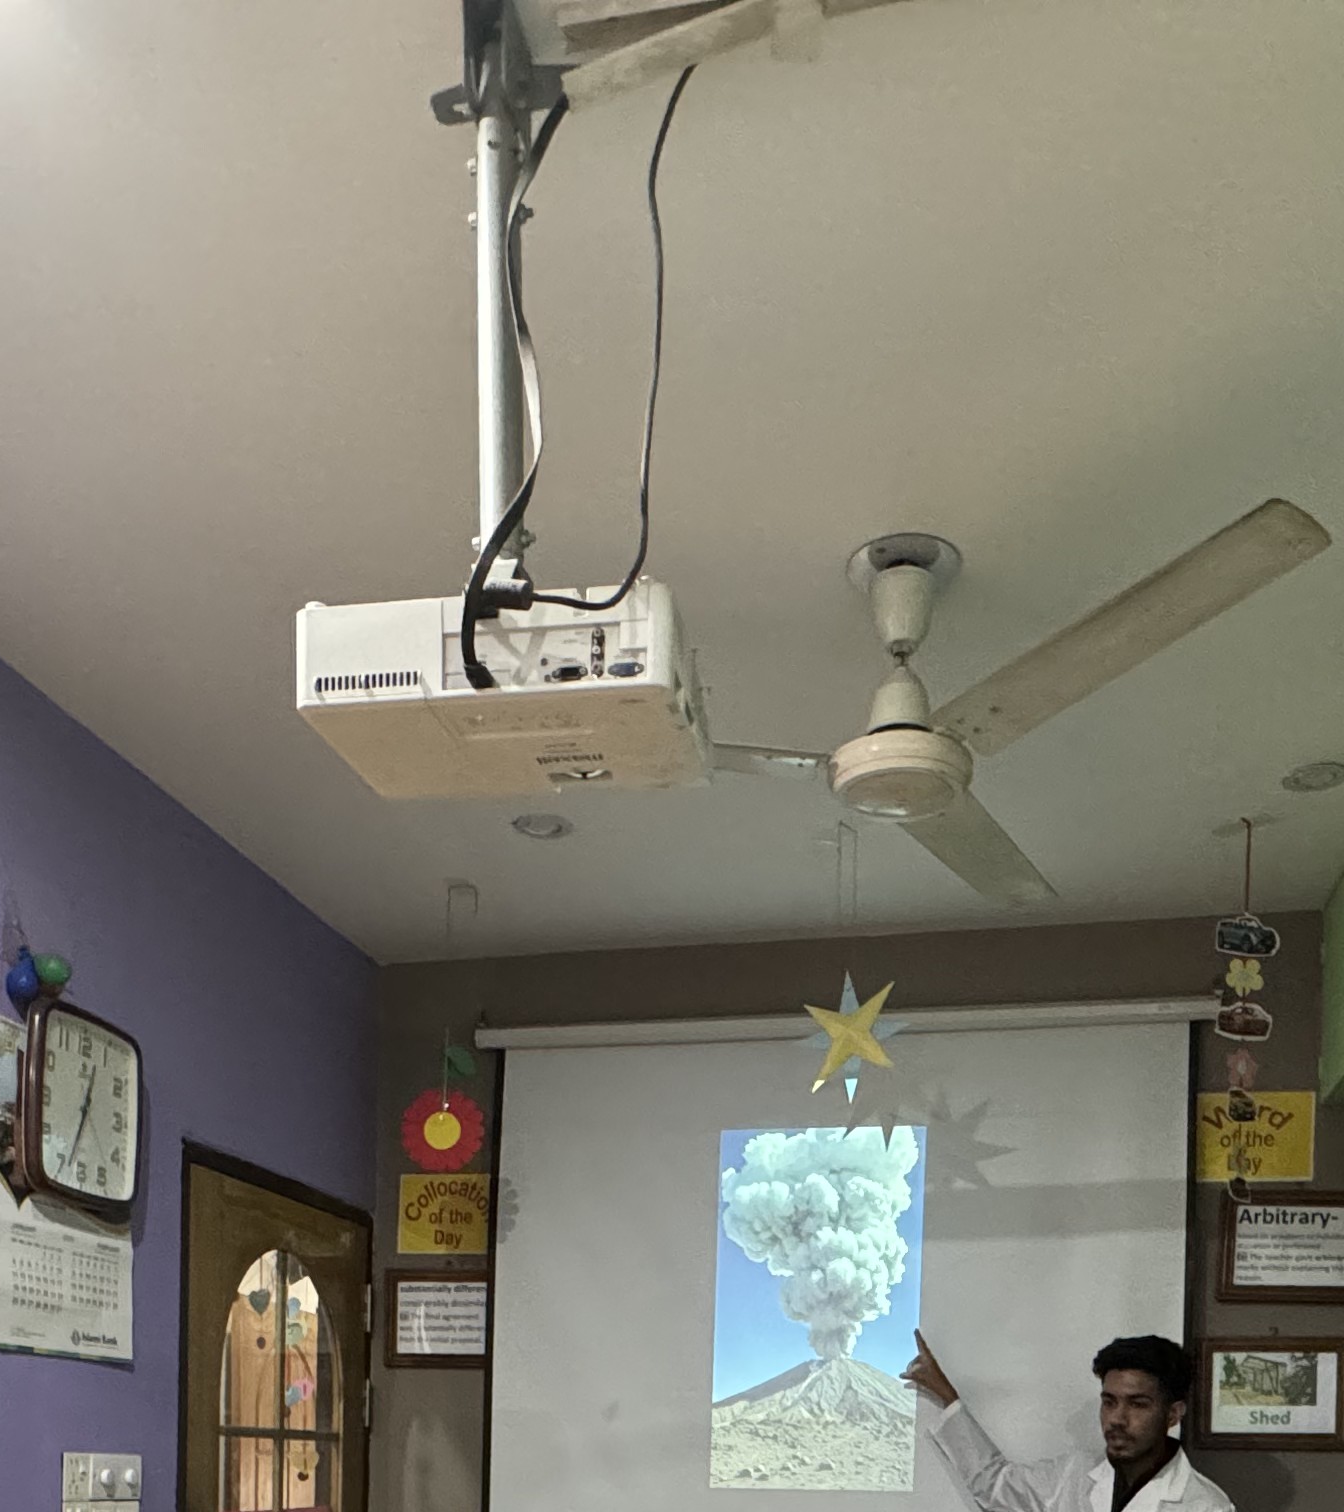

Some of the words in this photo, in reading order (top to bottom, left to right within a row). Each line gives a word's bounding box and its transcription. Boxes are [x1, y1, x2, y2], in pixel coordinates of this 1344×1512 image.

[78, 1034, 93, 1059] 12
[112, 1076, 124, 1099] 2
[112, 1112, 124, 1133] 3
[1202, 1105, 1295, 1131] Wrd
[1245, 1130, 1275, 1148] the
[56, 1153, 66, 1173] 7
[110, 1147, 121, 1167] 4
[429, 1207, 445, 1225] of
[449, 1208, 473, 1225] the
[1238, 1207, 1339, 1229] Arbitrary-
[434, 1229, 463, 1250] Day
[400, 1284, 452, 1294] substantially
[453, 1284, 487, 1293] differen
[451, 1298, 485, 1308] dissimila
[1248, 1409, 1292, 1426] Shed
